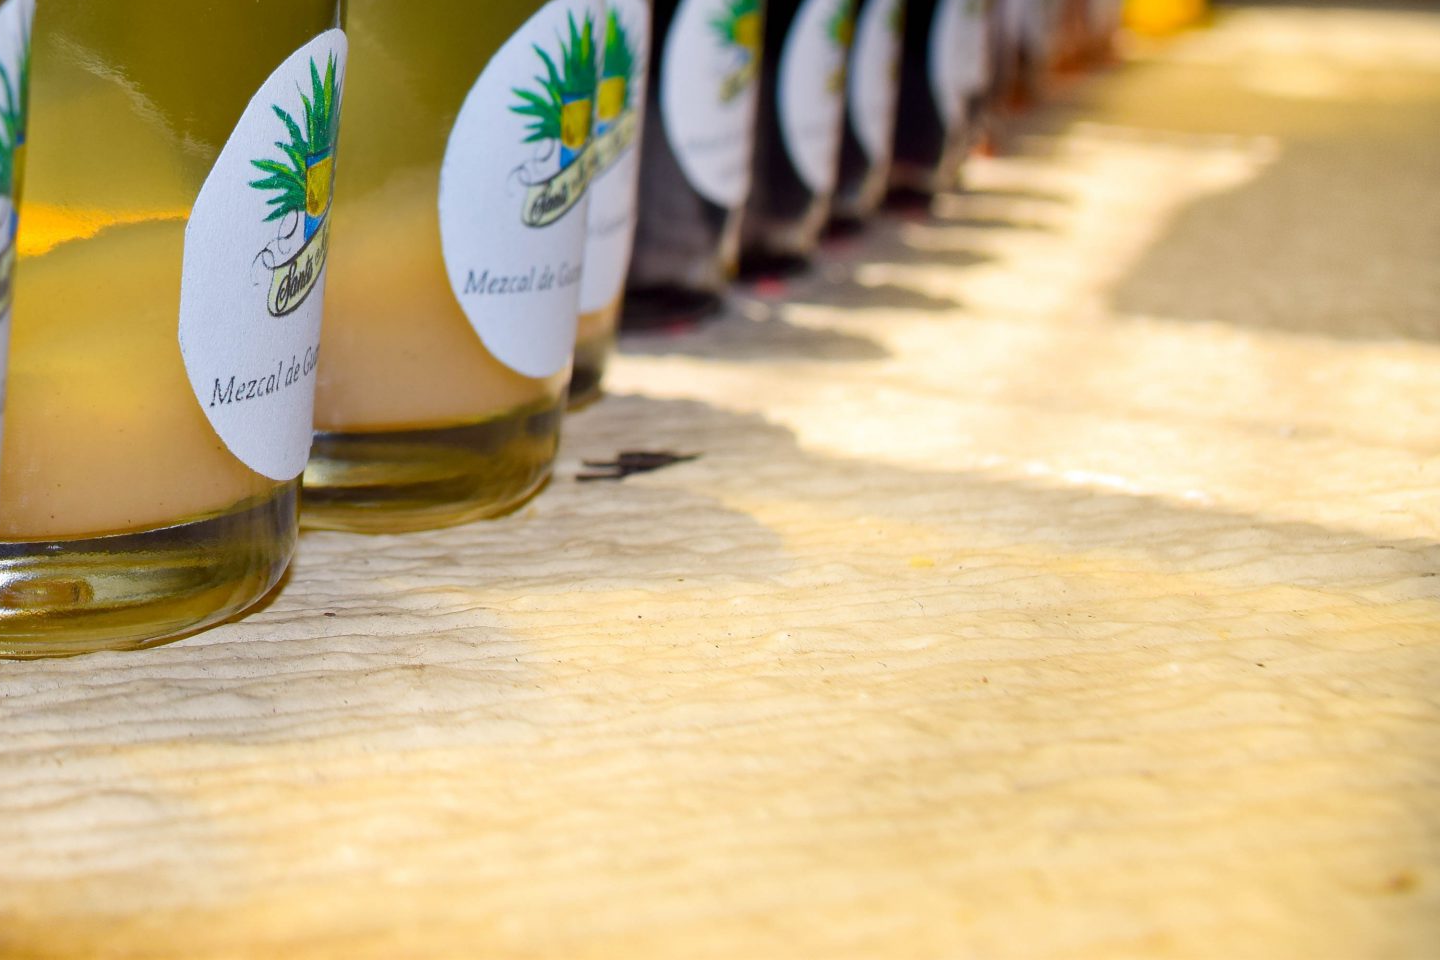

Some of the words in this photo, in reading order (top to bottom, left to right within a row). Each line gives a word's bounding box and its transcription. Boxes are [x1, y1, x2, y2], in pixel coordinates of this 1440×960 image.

[463, 265, 536, 295] Mezcal
[209, 361, 282, 407] Mezcal
[284, 354, 300, 388] de
